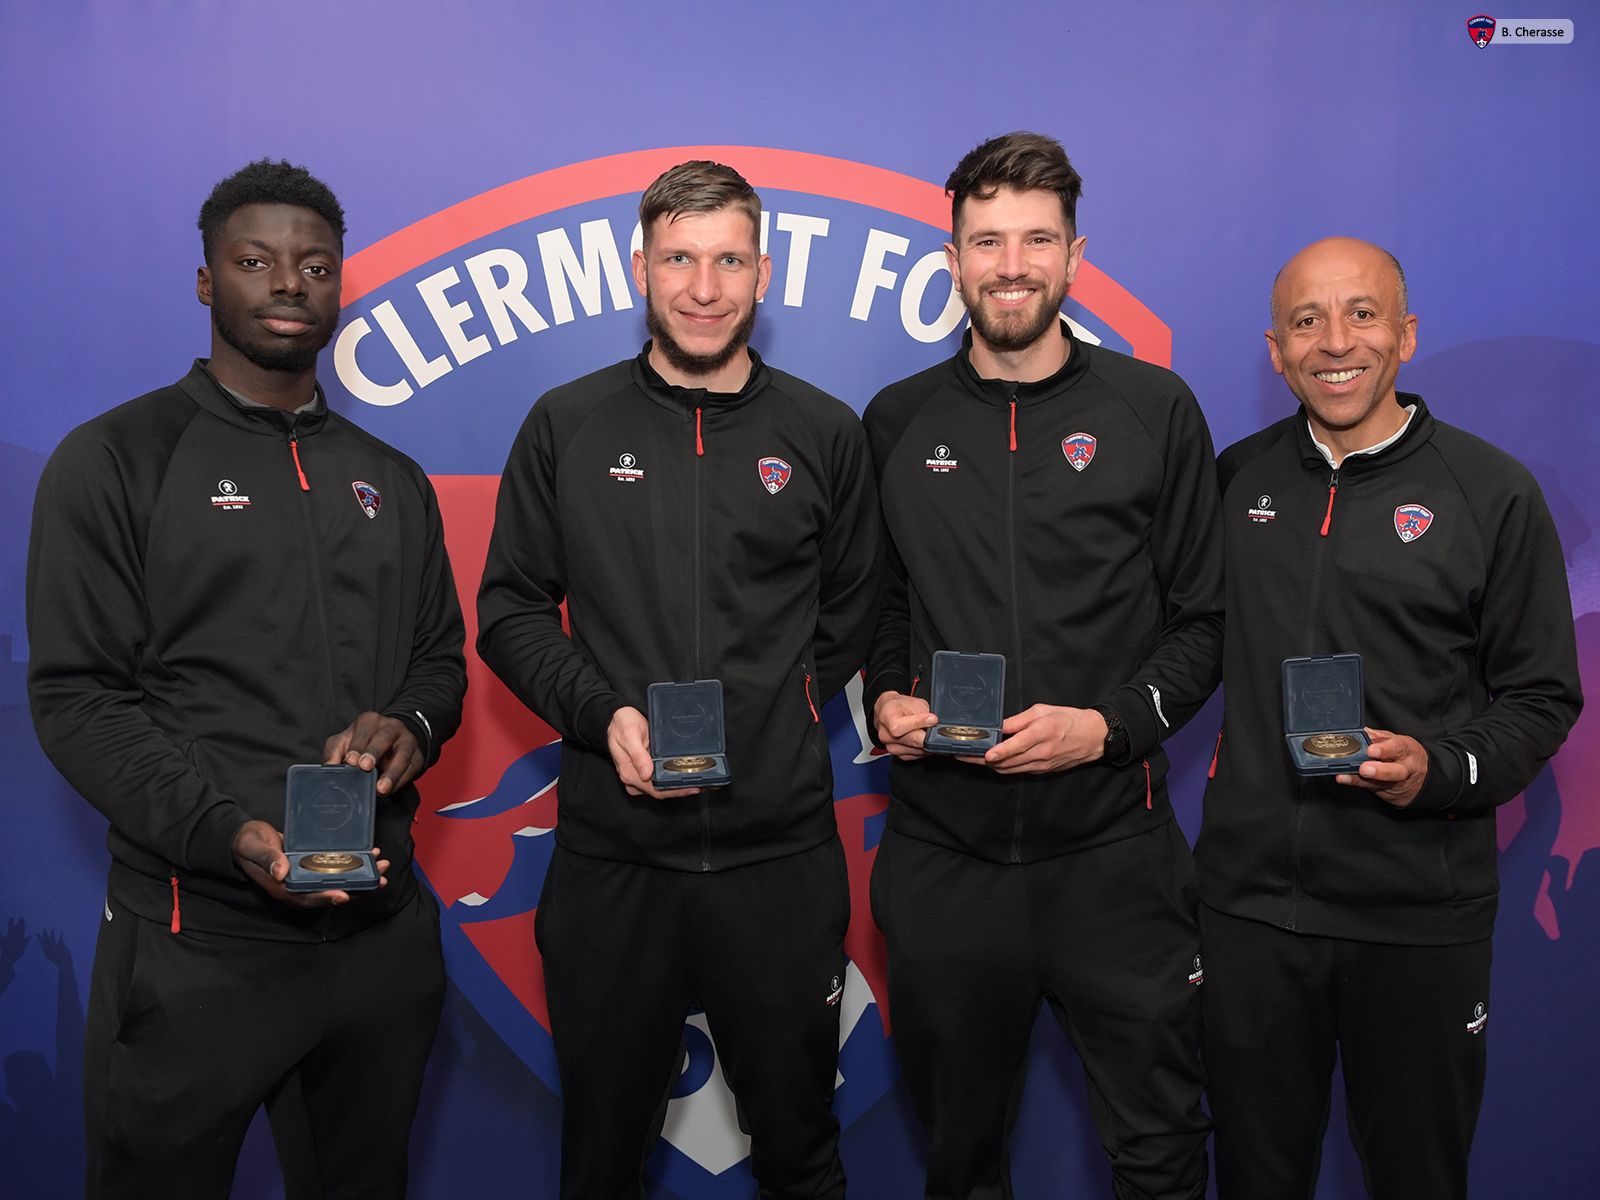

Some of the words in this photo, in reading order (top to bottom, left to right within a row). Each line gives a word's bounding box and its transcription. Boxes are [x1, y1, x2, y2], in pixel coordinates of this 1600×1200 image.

[334, 211, 830, 406] CLERMT
[609, 467, 644, 476] PATRICK
[211, 495, 251, 503] PATRICK
[1248, 508, 1277, 517] PATRICK
